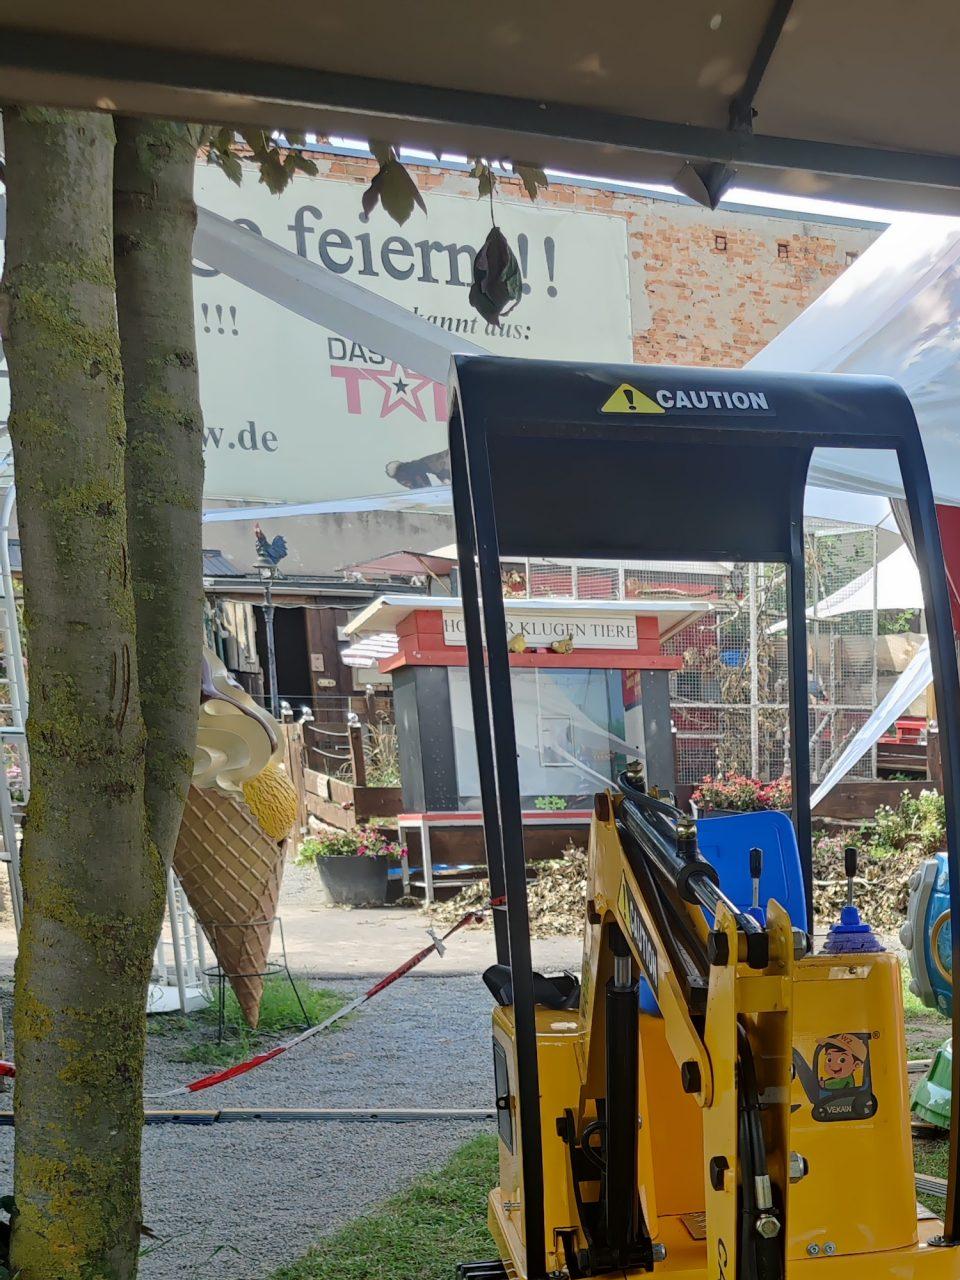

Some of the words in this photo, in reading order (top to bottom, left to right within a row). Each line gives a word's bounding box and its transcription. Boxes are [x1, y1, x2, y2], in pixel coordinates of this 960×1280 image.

[656, 388, 769, 411] CAUTION
[520, 622, 586, 637] KLUGEN
[590, 624, 636, 638] TIERE
[630, 904, 658, 986] CAUTION
